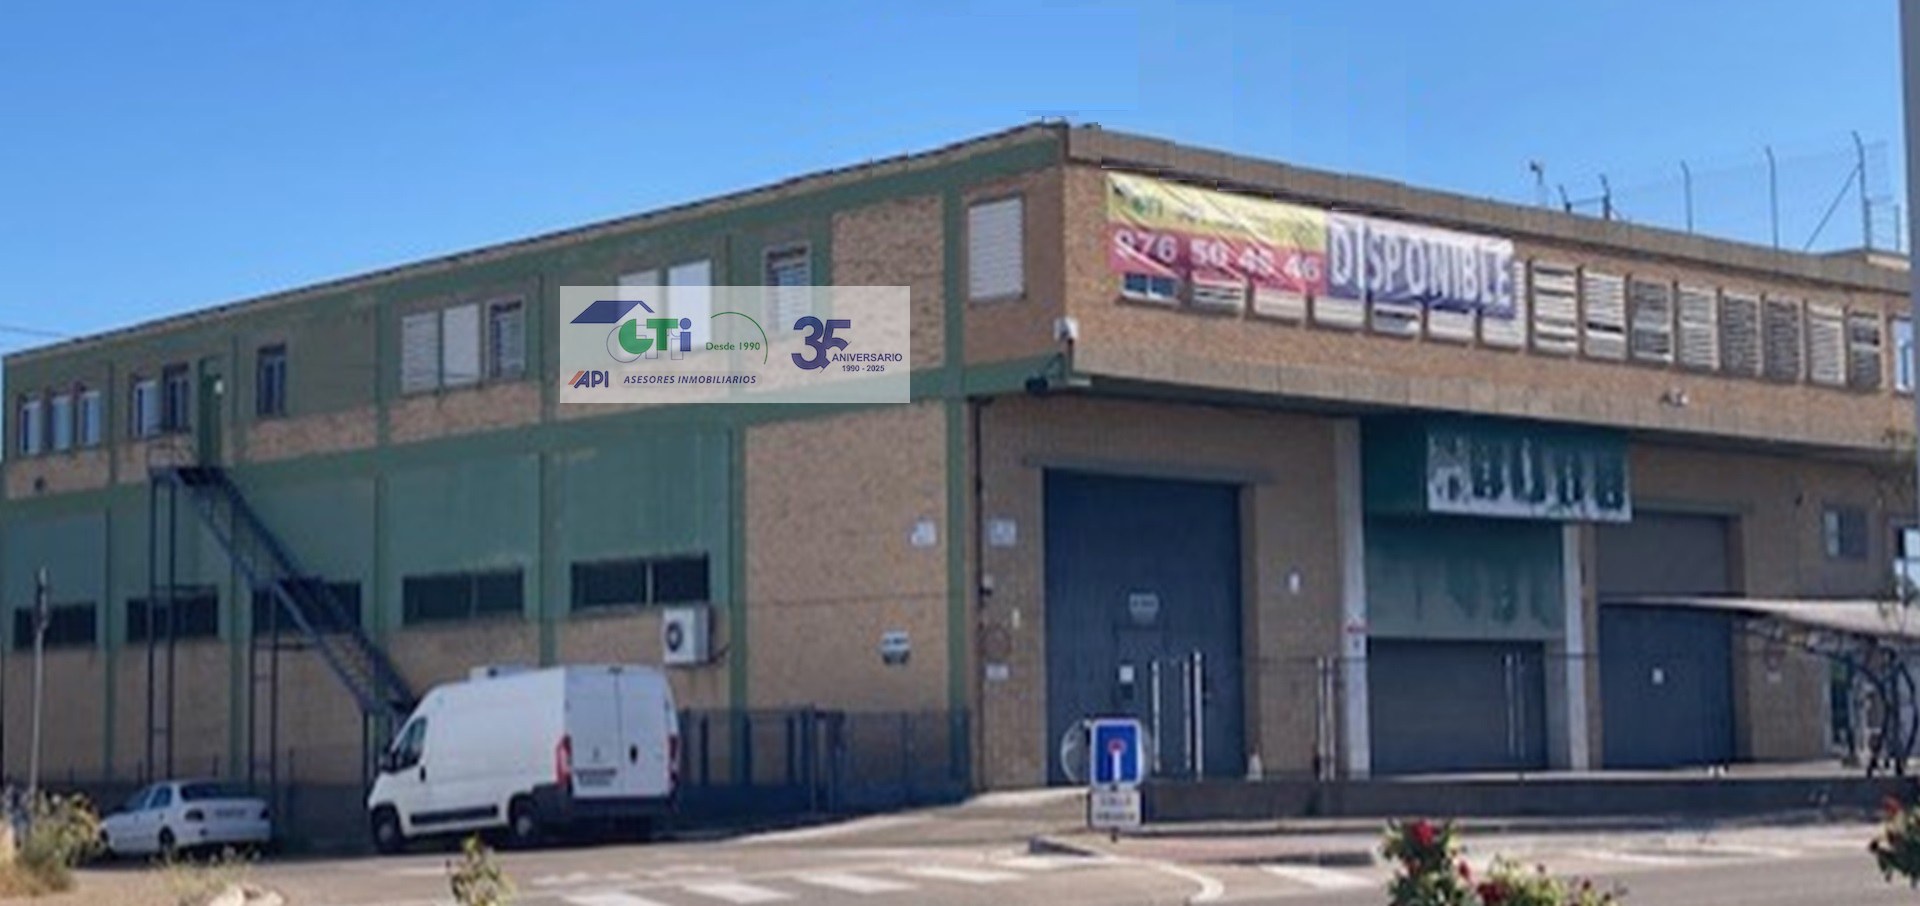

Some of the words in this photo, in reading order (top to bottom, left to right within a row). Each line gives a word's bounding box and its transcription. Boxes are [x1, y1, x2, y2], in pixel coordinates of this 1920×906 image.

[1114, 229, 1178, 264] 976
[1284, 254, 1321, 282] 46
[1331, 219, 1511, 306] DISPONIBLE
